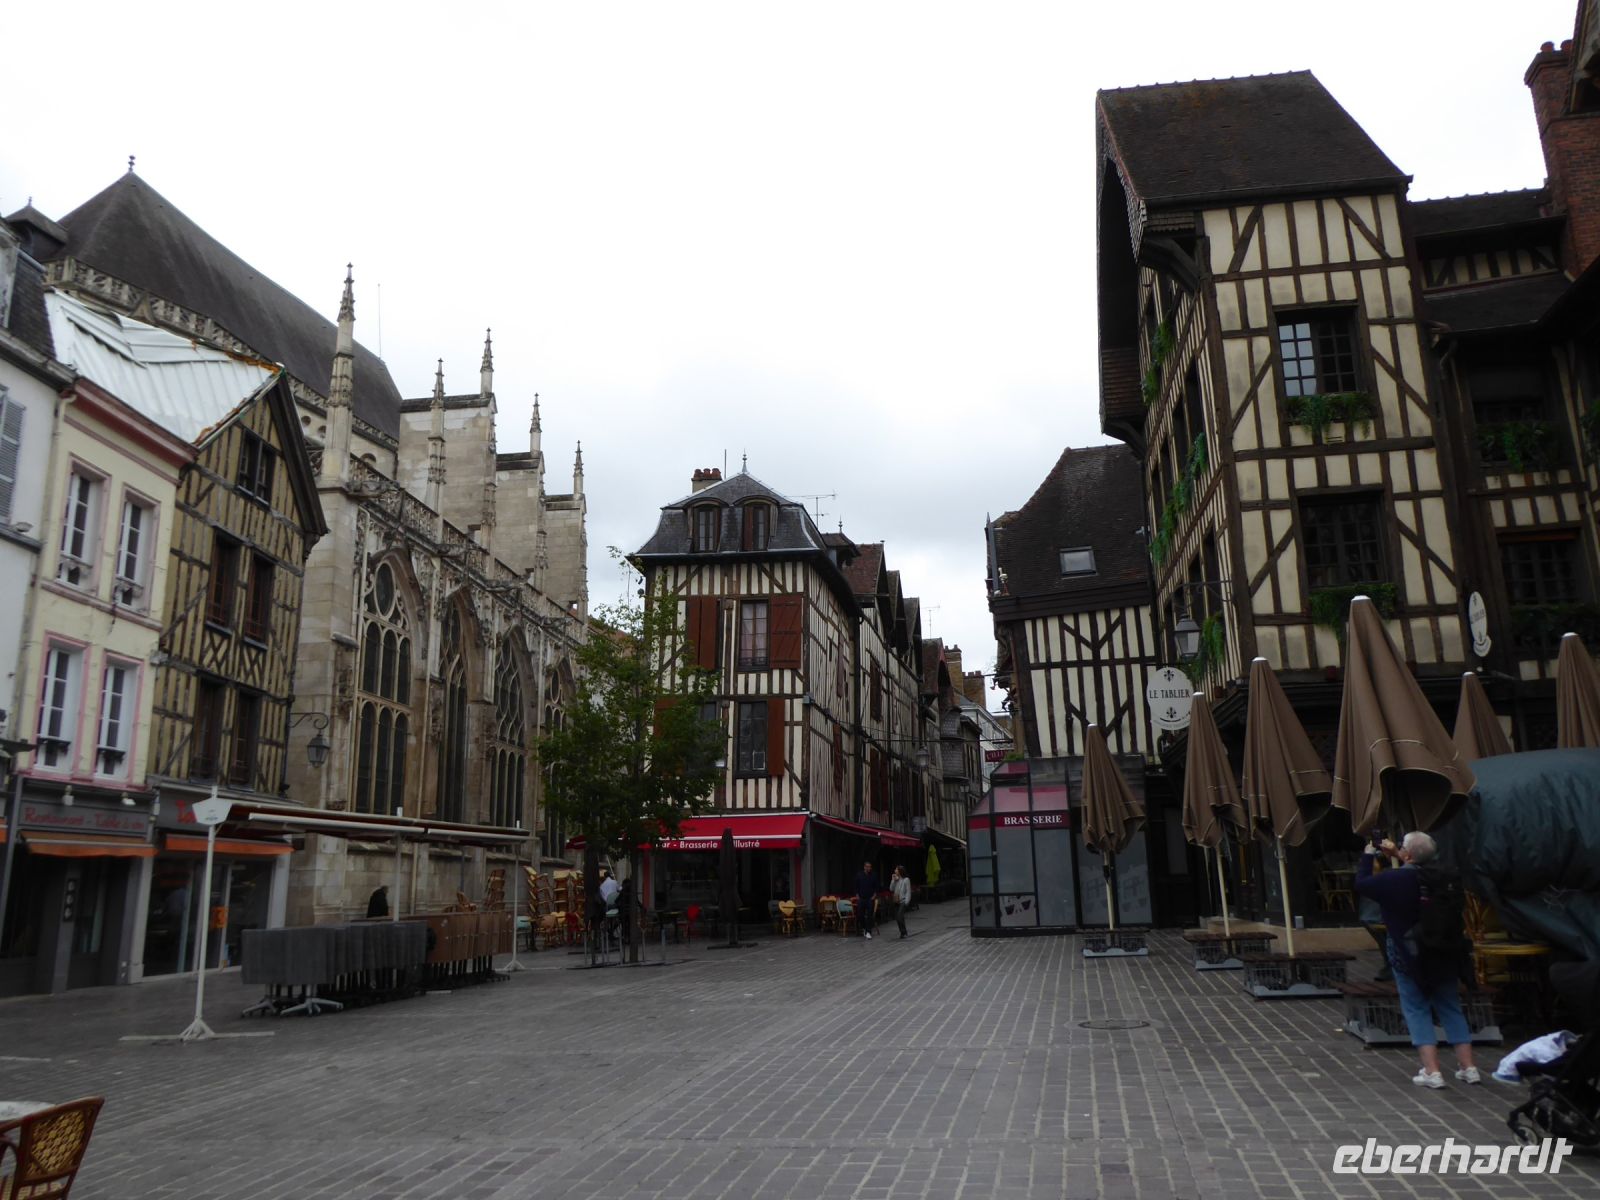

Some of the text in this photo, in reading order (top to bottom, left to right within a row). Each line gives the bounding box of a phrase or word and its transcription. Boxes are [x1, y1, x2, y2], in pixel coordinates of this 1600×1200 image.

[1149, 688, 1190, 699] LE TABLIER
[24, 807, 84, 825] Restaurant
[1004, 815, 1062, 824] BRASSERIE
[680, 840, 718, 848] Brasserie
